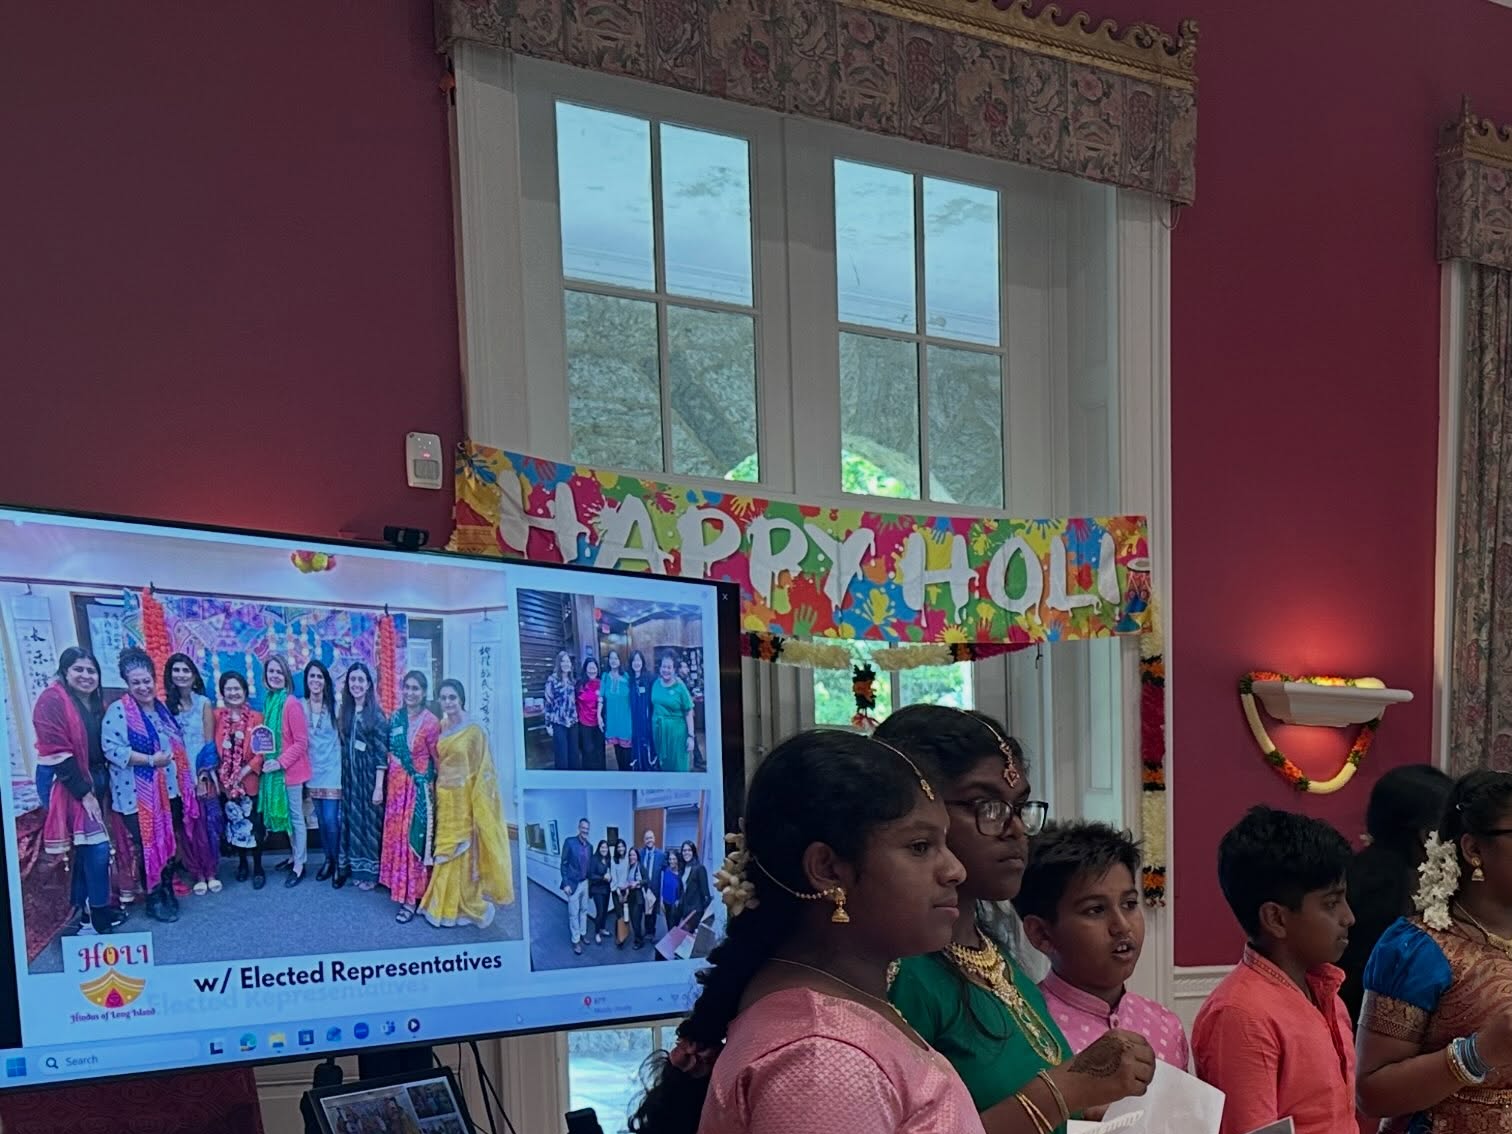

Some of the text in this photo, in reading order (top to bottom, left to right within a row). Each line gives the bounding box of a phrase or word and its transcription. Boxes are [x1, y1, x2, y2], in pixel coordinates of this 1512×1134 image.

[499, 470, 1120, 625] HAPPY HOLI
[78, 942, 148, 973] HOLI
[194, 951, 502, 994] w/ Elected Representatives
[70, 1008, 156, 1024] Hindus of Long Island
[65, 1054, 98, 1067] Search
